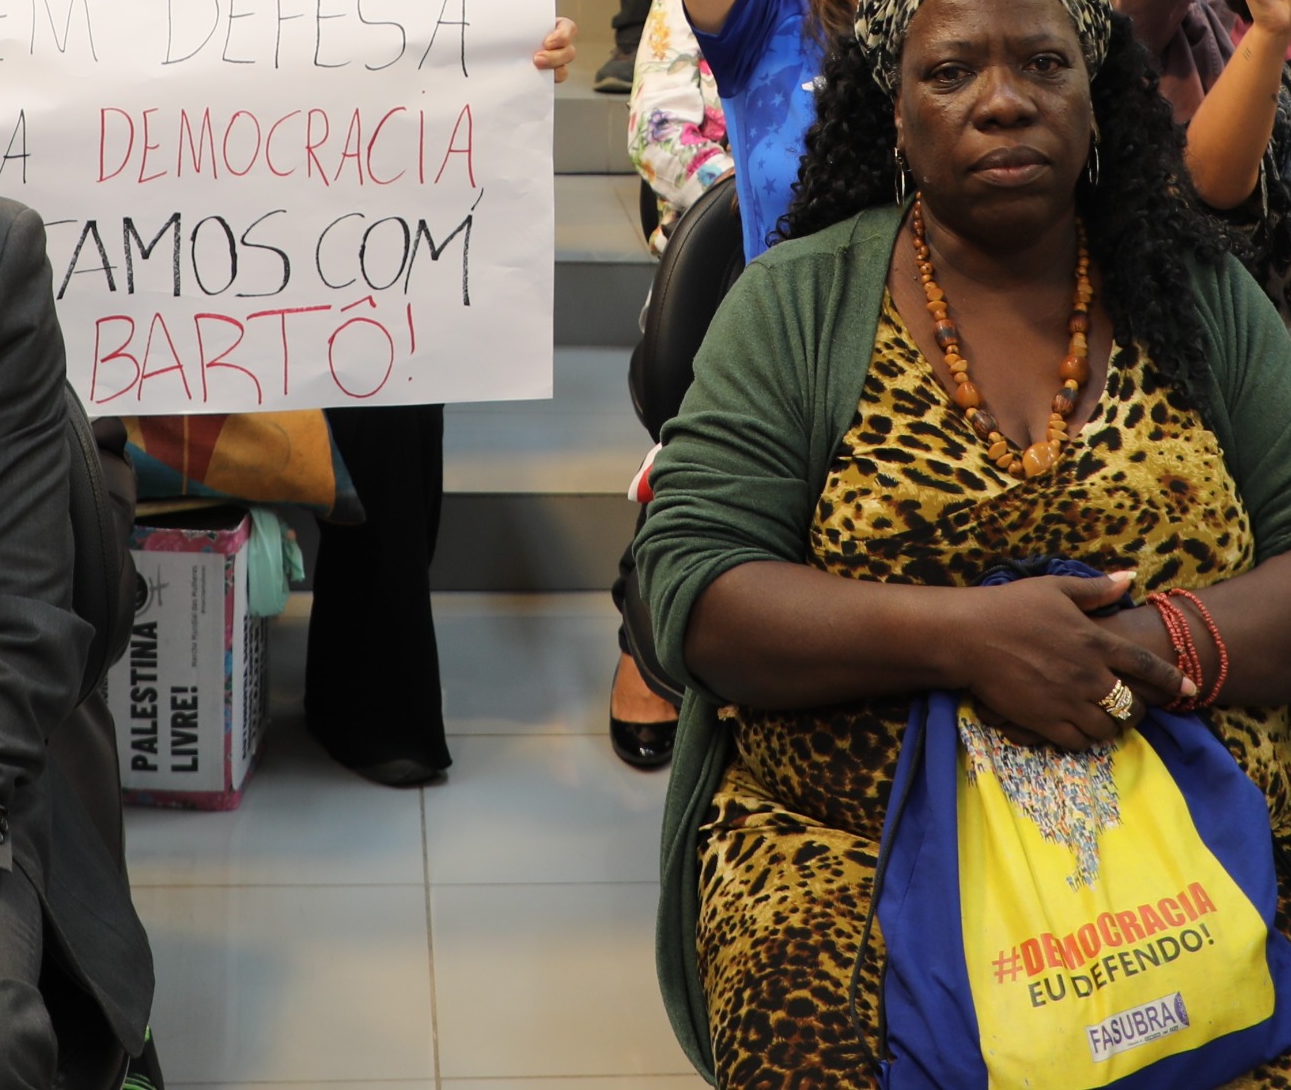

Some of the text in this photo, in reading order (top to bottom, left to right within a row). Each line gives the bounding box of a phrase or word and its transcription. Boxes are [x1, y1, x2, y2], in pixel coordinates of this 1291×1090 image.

[315, 210, 475, 307] COM
[89, 294, 416, 405] BARTÔ!
[130, 621, 159, 773] PALESTINA
[170, 685, 199, 773] LIVRE!
[992, 881, 1218, 985] #DEMOCRACIA
[1027, 922, 1216, 1009] EU DEFENDO!
[1089, 1001, 1177, 1054] FASUBRA
